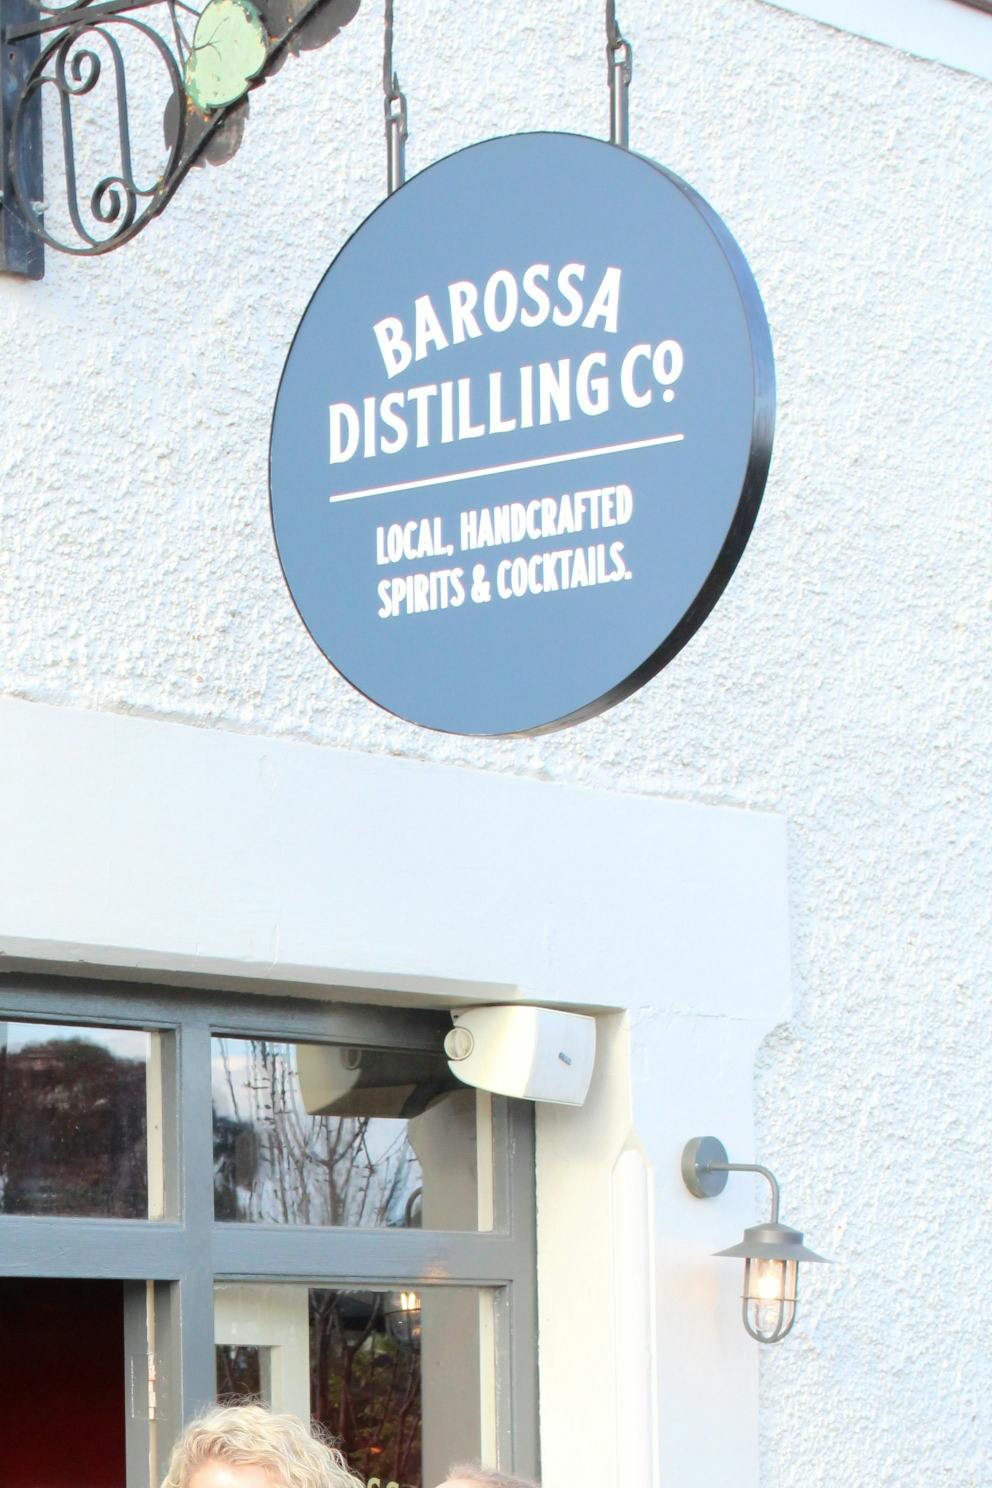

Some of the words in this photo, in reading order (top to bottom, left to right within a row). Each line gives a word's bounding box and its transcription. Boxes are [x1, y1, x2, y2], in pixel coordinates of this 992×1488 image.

[372, 262, 622, 379] BAROSSA
[328, 351, 610, 465] DISTILLING
[376, 516, 455, 565] LOCAL,
[460, 484, 634, 552] HANDCRAFTED
[377, 567, 466, 619] SPIRITS
[470, 563, 492, 604] &
[496, 541, 633, 600] COCKTAILS.
